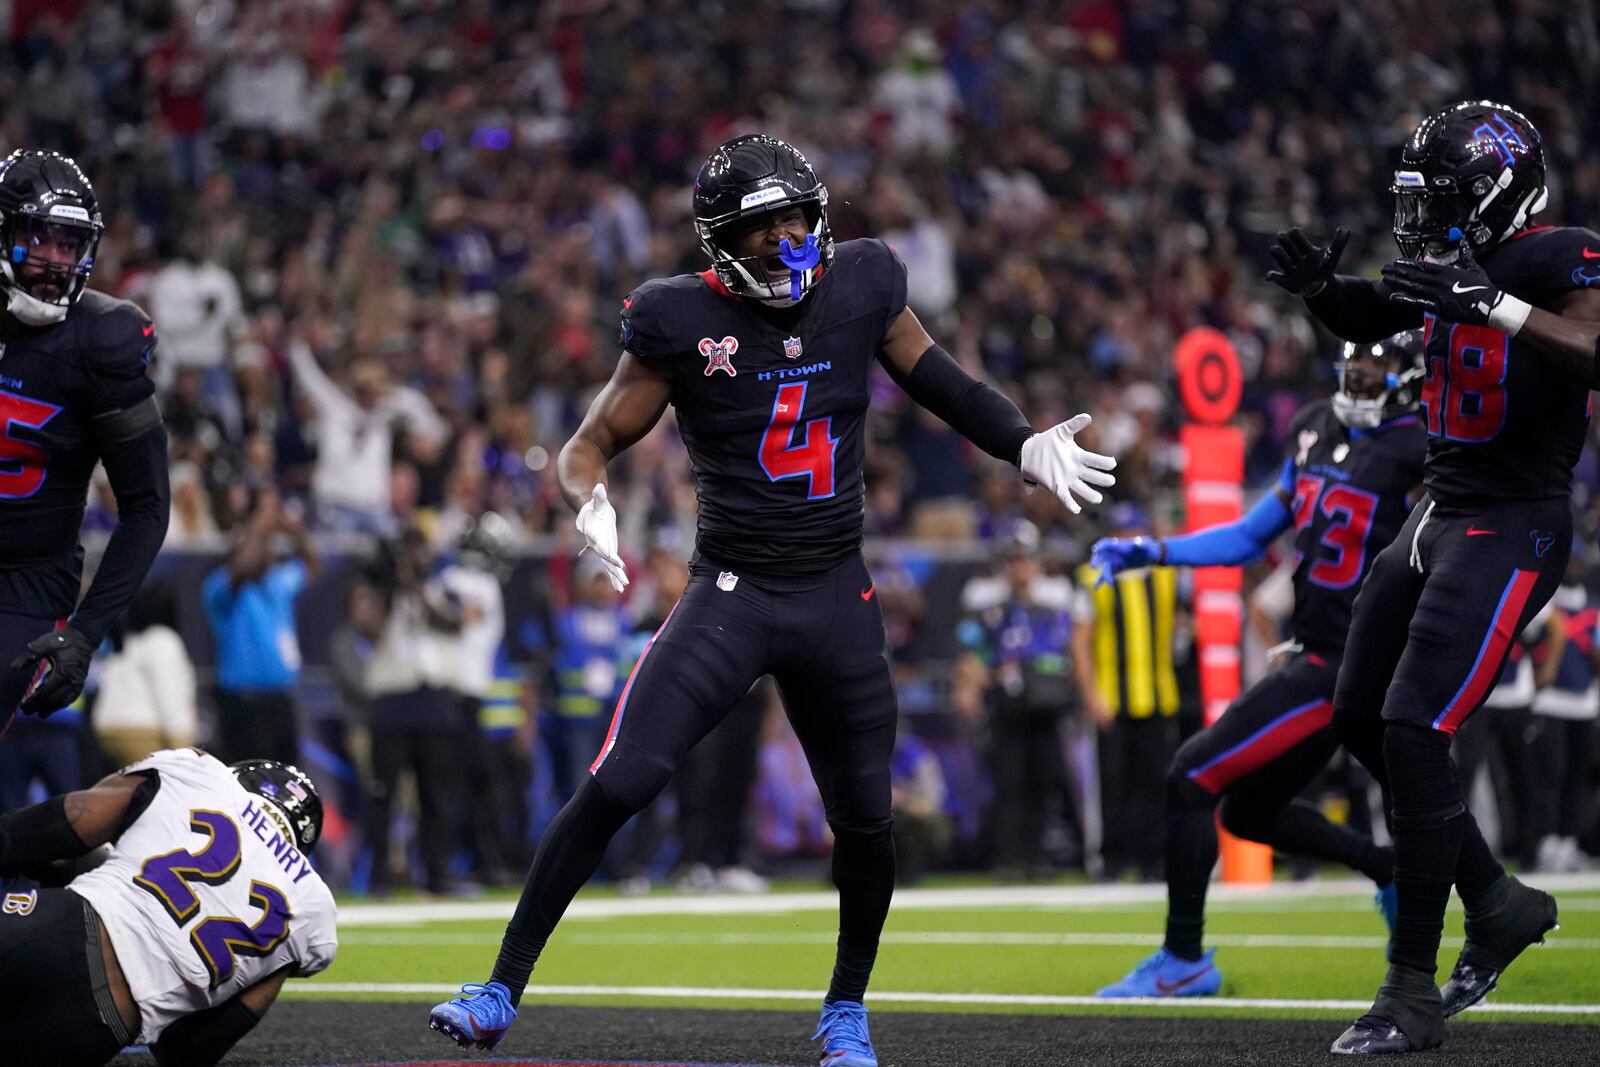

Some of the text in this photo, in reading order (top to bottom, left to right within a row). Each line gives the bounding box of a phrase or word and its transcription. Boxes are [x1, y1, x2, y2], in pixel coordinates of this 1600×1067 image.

[757, 360, 833, 381] H-TOWN
[1420, 311, 1510, 443] 48
[757, 380, 841, 500] 4
[241, 799, 312, 884] HENRY
[260, 802, 295, 846] RAVE
[2, 888, 38, 917] B
[132, 808, 291, 991] 22
